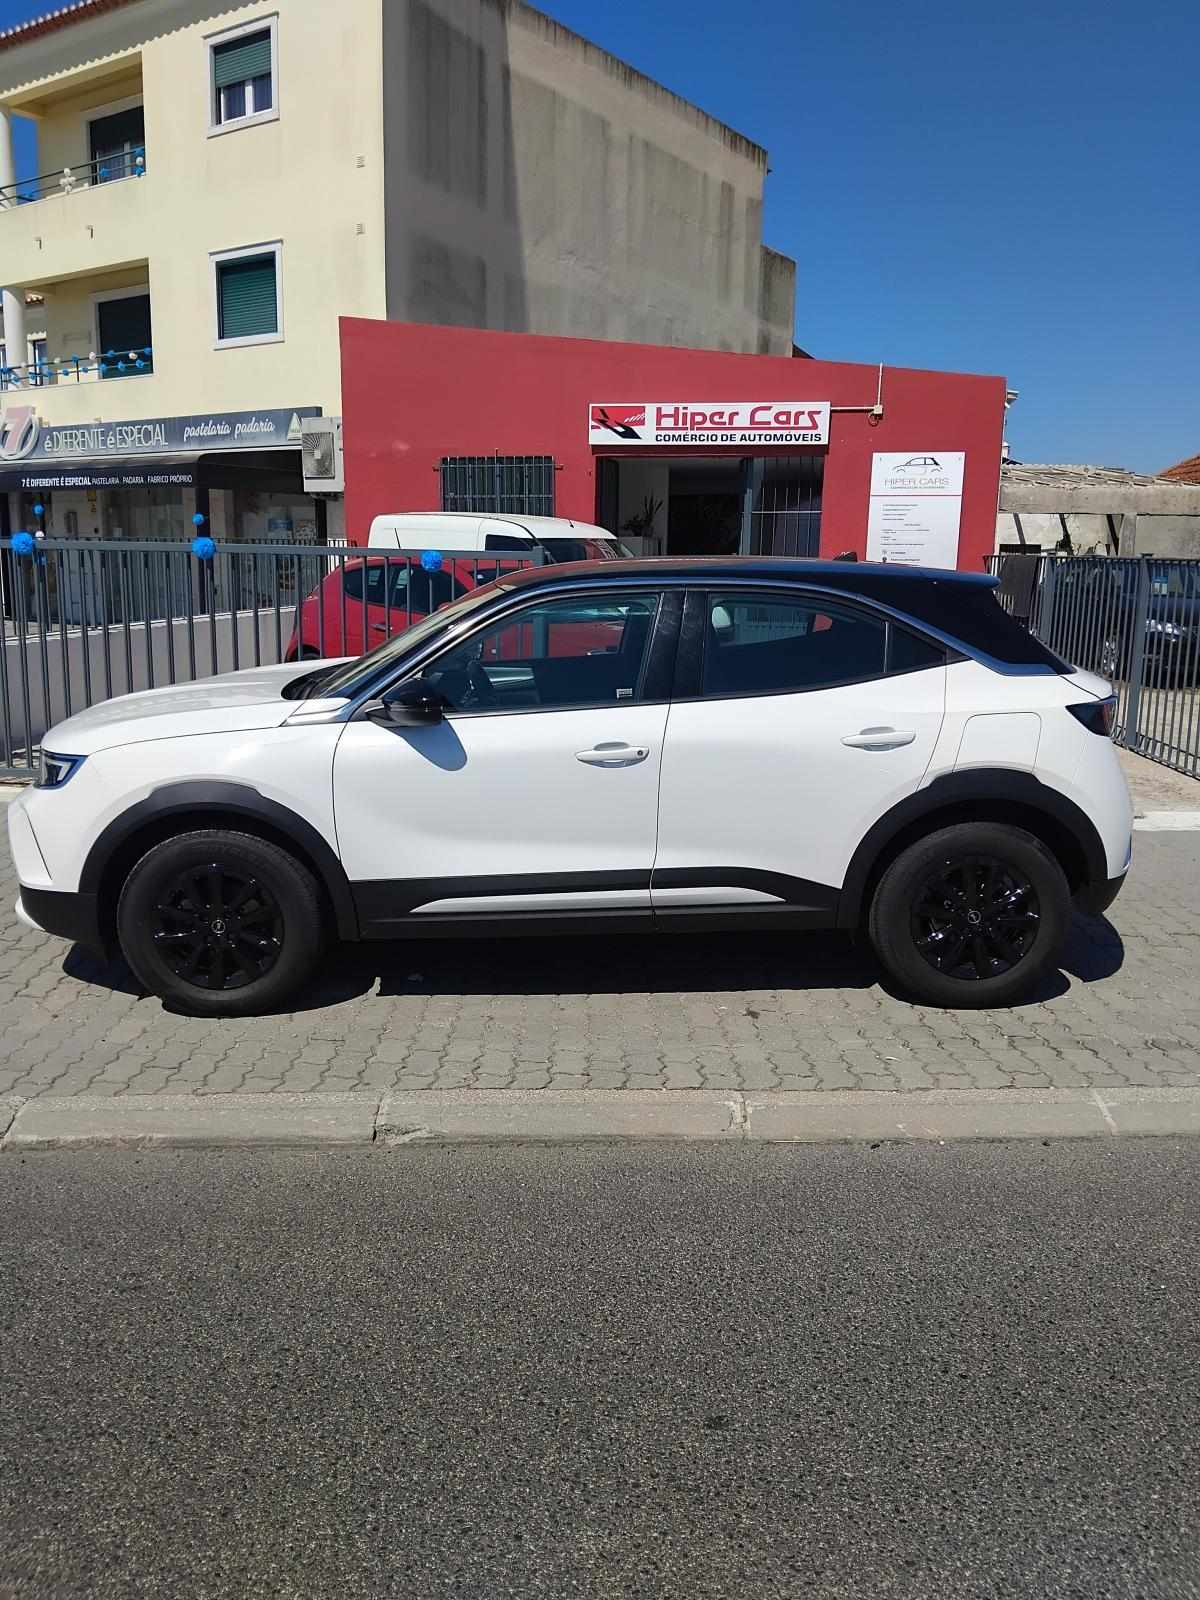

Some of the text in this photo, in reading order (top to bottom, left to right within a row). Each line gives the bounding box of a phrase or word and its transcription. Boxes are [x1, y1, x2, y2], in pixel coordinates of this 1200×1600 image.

[656, 406, 822, 431] Hiper Cars
[44, 416, 275, 452] é DIFERENTE é ESPECIAL pastelaria padaria
[655, 431, 822, 442] COMÉRCIO DE AUTOMÓVEIS
[31, 477, 60, 486] DIFERENTE
[65, 475, 92, 486] ESPECIAL
[92, 476, 120, 485] PASTELARIA
[122, 475, 144, 484] PADARIA
[147, 474, 169, 483] FABRICO
[170, 474, 193, 483] PRÓPRIO
[884, 477, 951, 486] HIPER CARS
